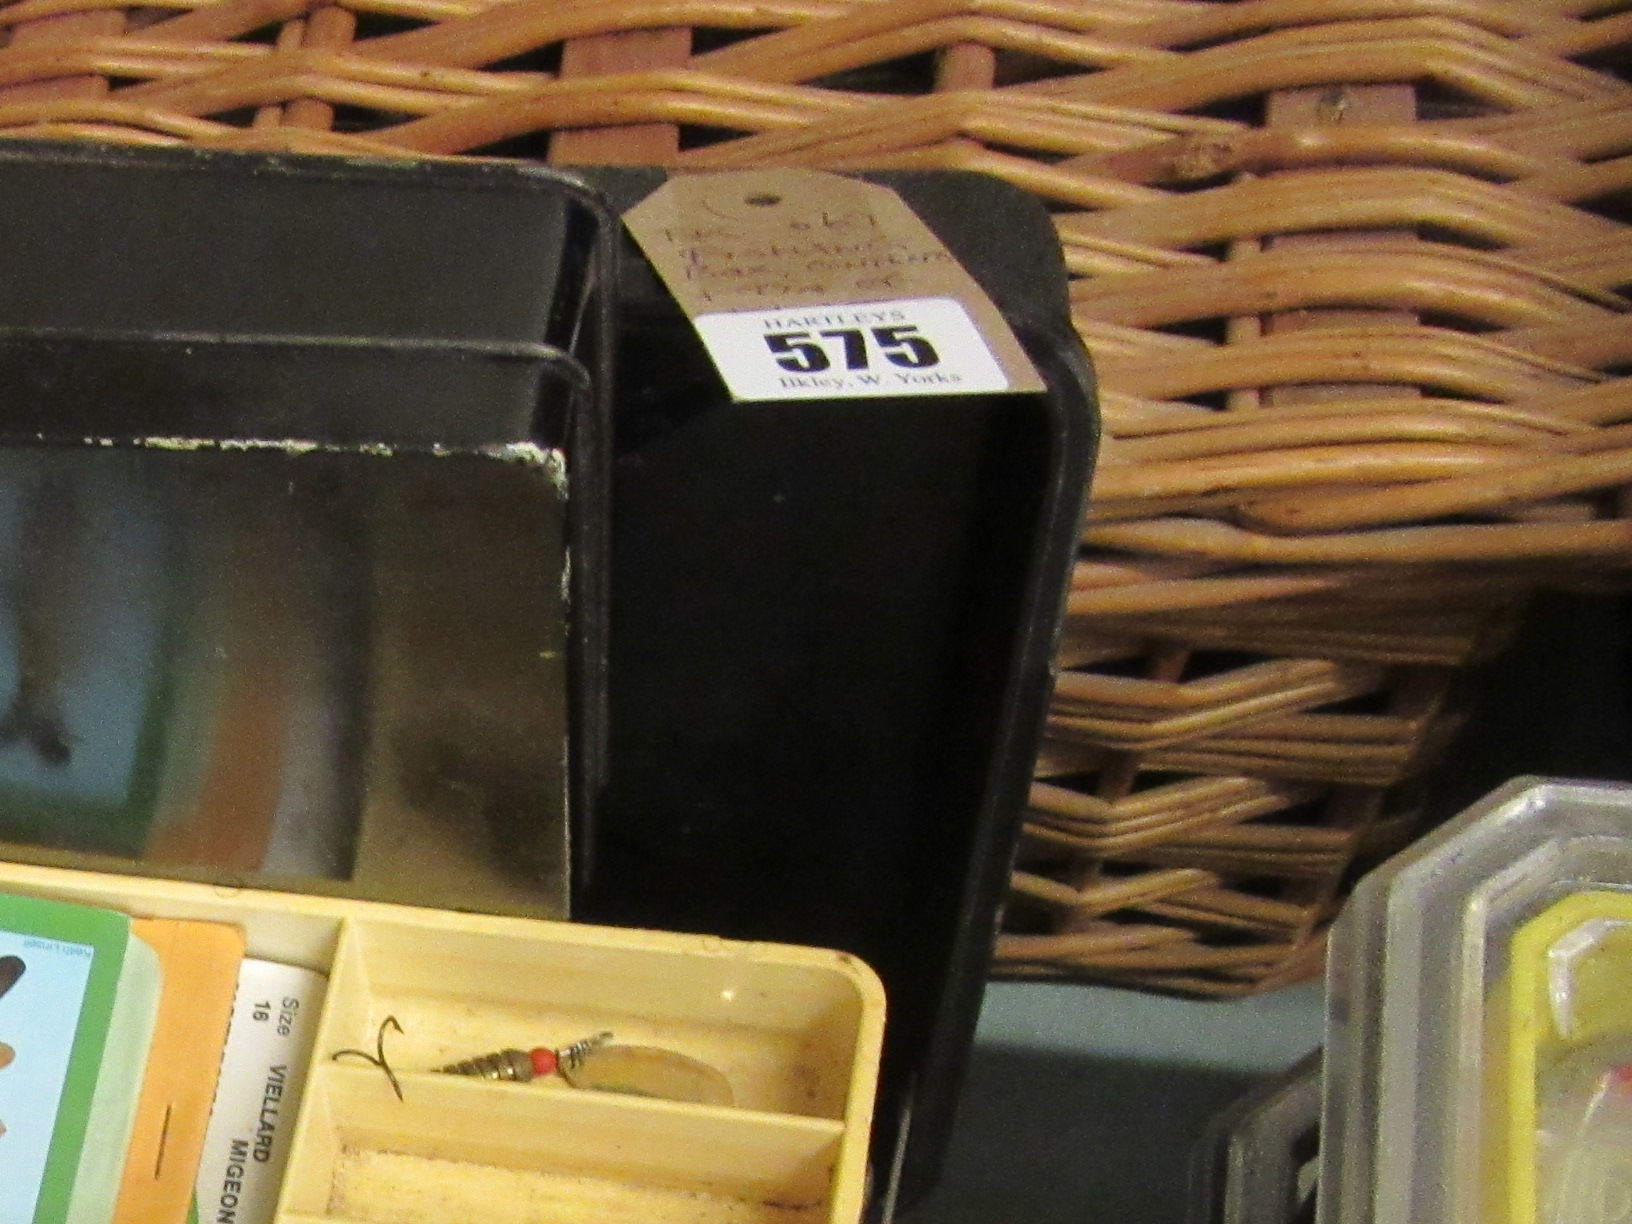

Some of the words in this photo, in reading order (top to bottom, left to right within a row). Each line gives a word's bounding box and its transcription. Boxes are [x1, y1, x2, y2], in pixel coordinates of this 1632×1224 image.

[764, 310, 907, 330] HARTLEYS
[763, 323, 941, 374] 575
[897, 371, 963, 386] Yorks
[276, 997, 299, 1037] Size
[252, 1066, 286, 1163] VIELLARD
[218, 1139, 247, 1224] MIGEON
